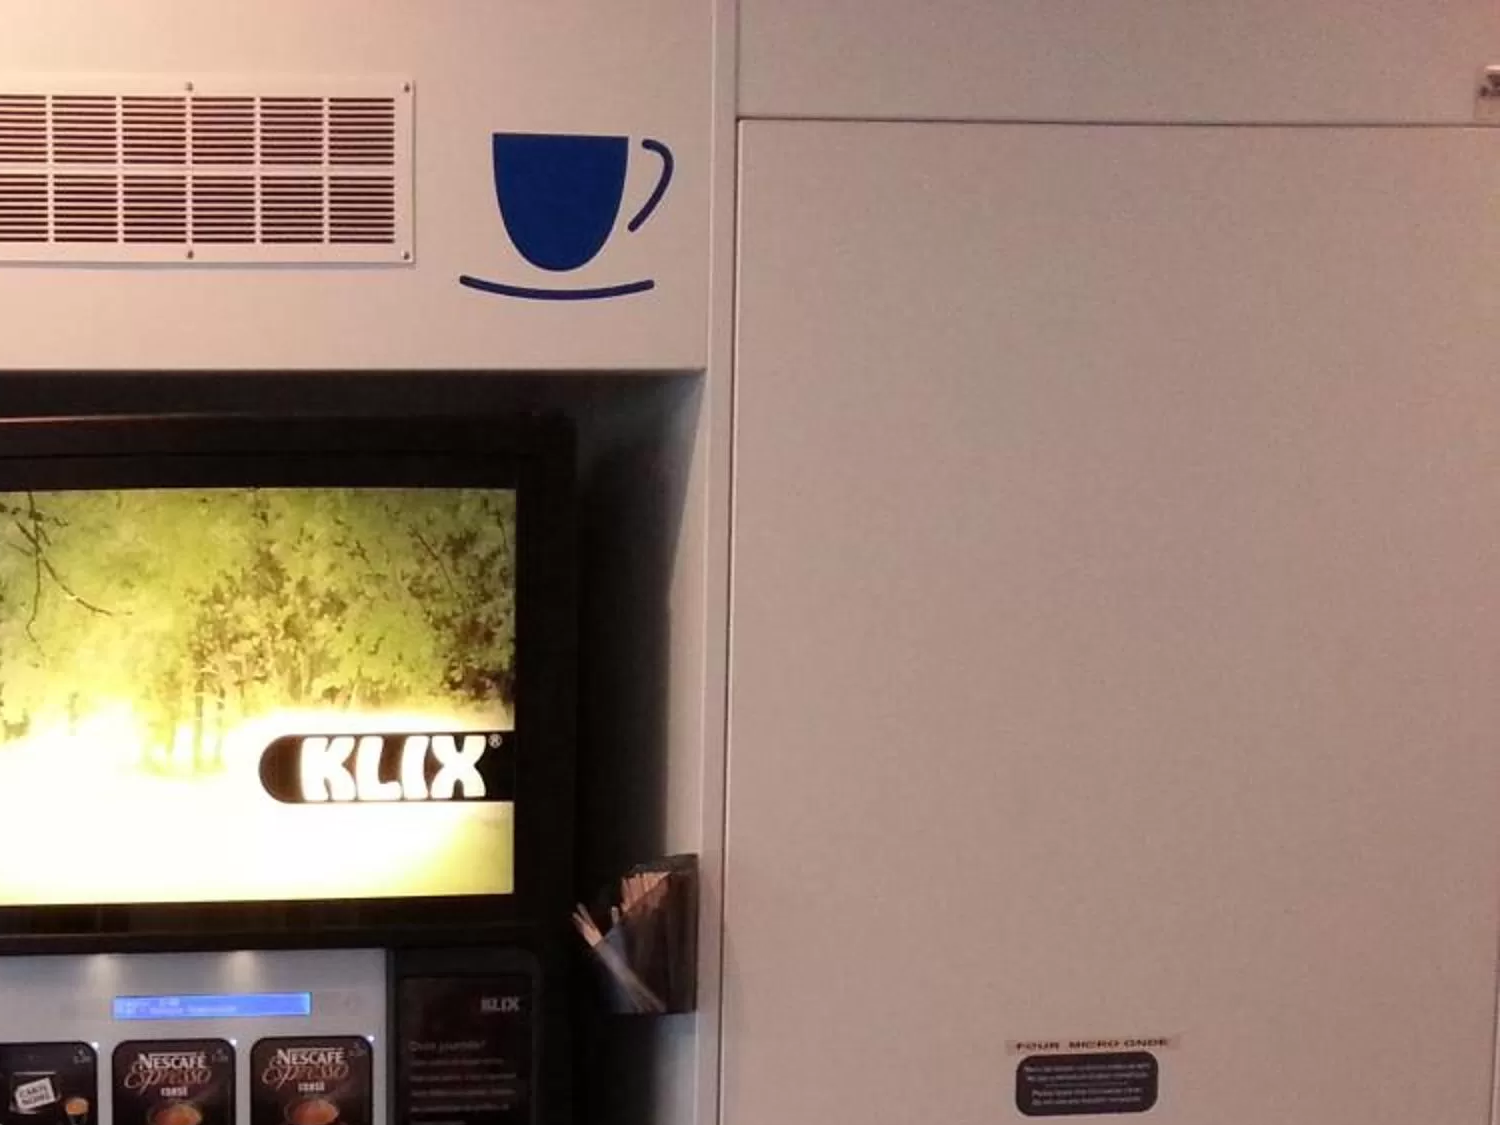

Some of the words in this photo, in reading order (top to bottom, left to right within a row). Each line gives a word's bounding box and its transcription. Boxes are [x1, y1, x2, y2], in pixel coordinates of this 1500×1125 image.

[300, 734, 487, 802] KLIX
[480, 996, 520, 1014] KLIX
[1015, 1041, 1060, 1050] FOUR
[1068, 1039, 1121, 1049] MICRO
